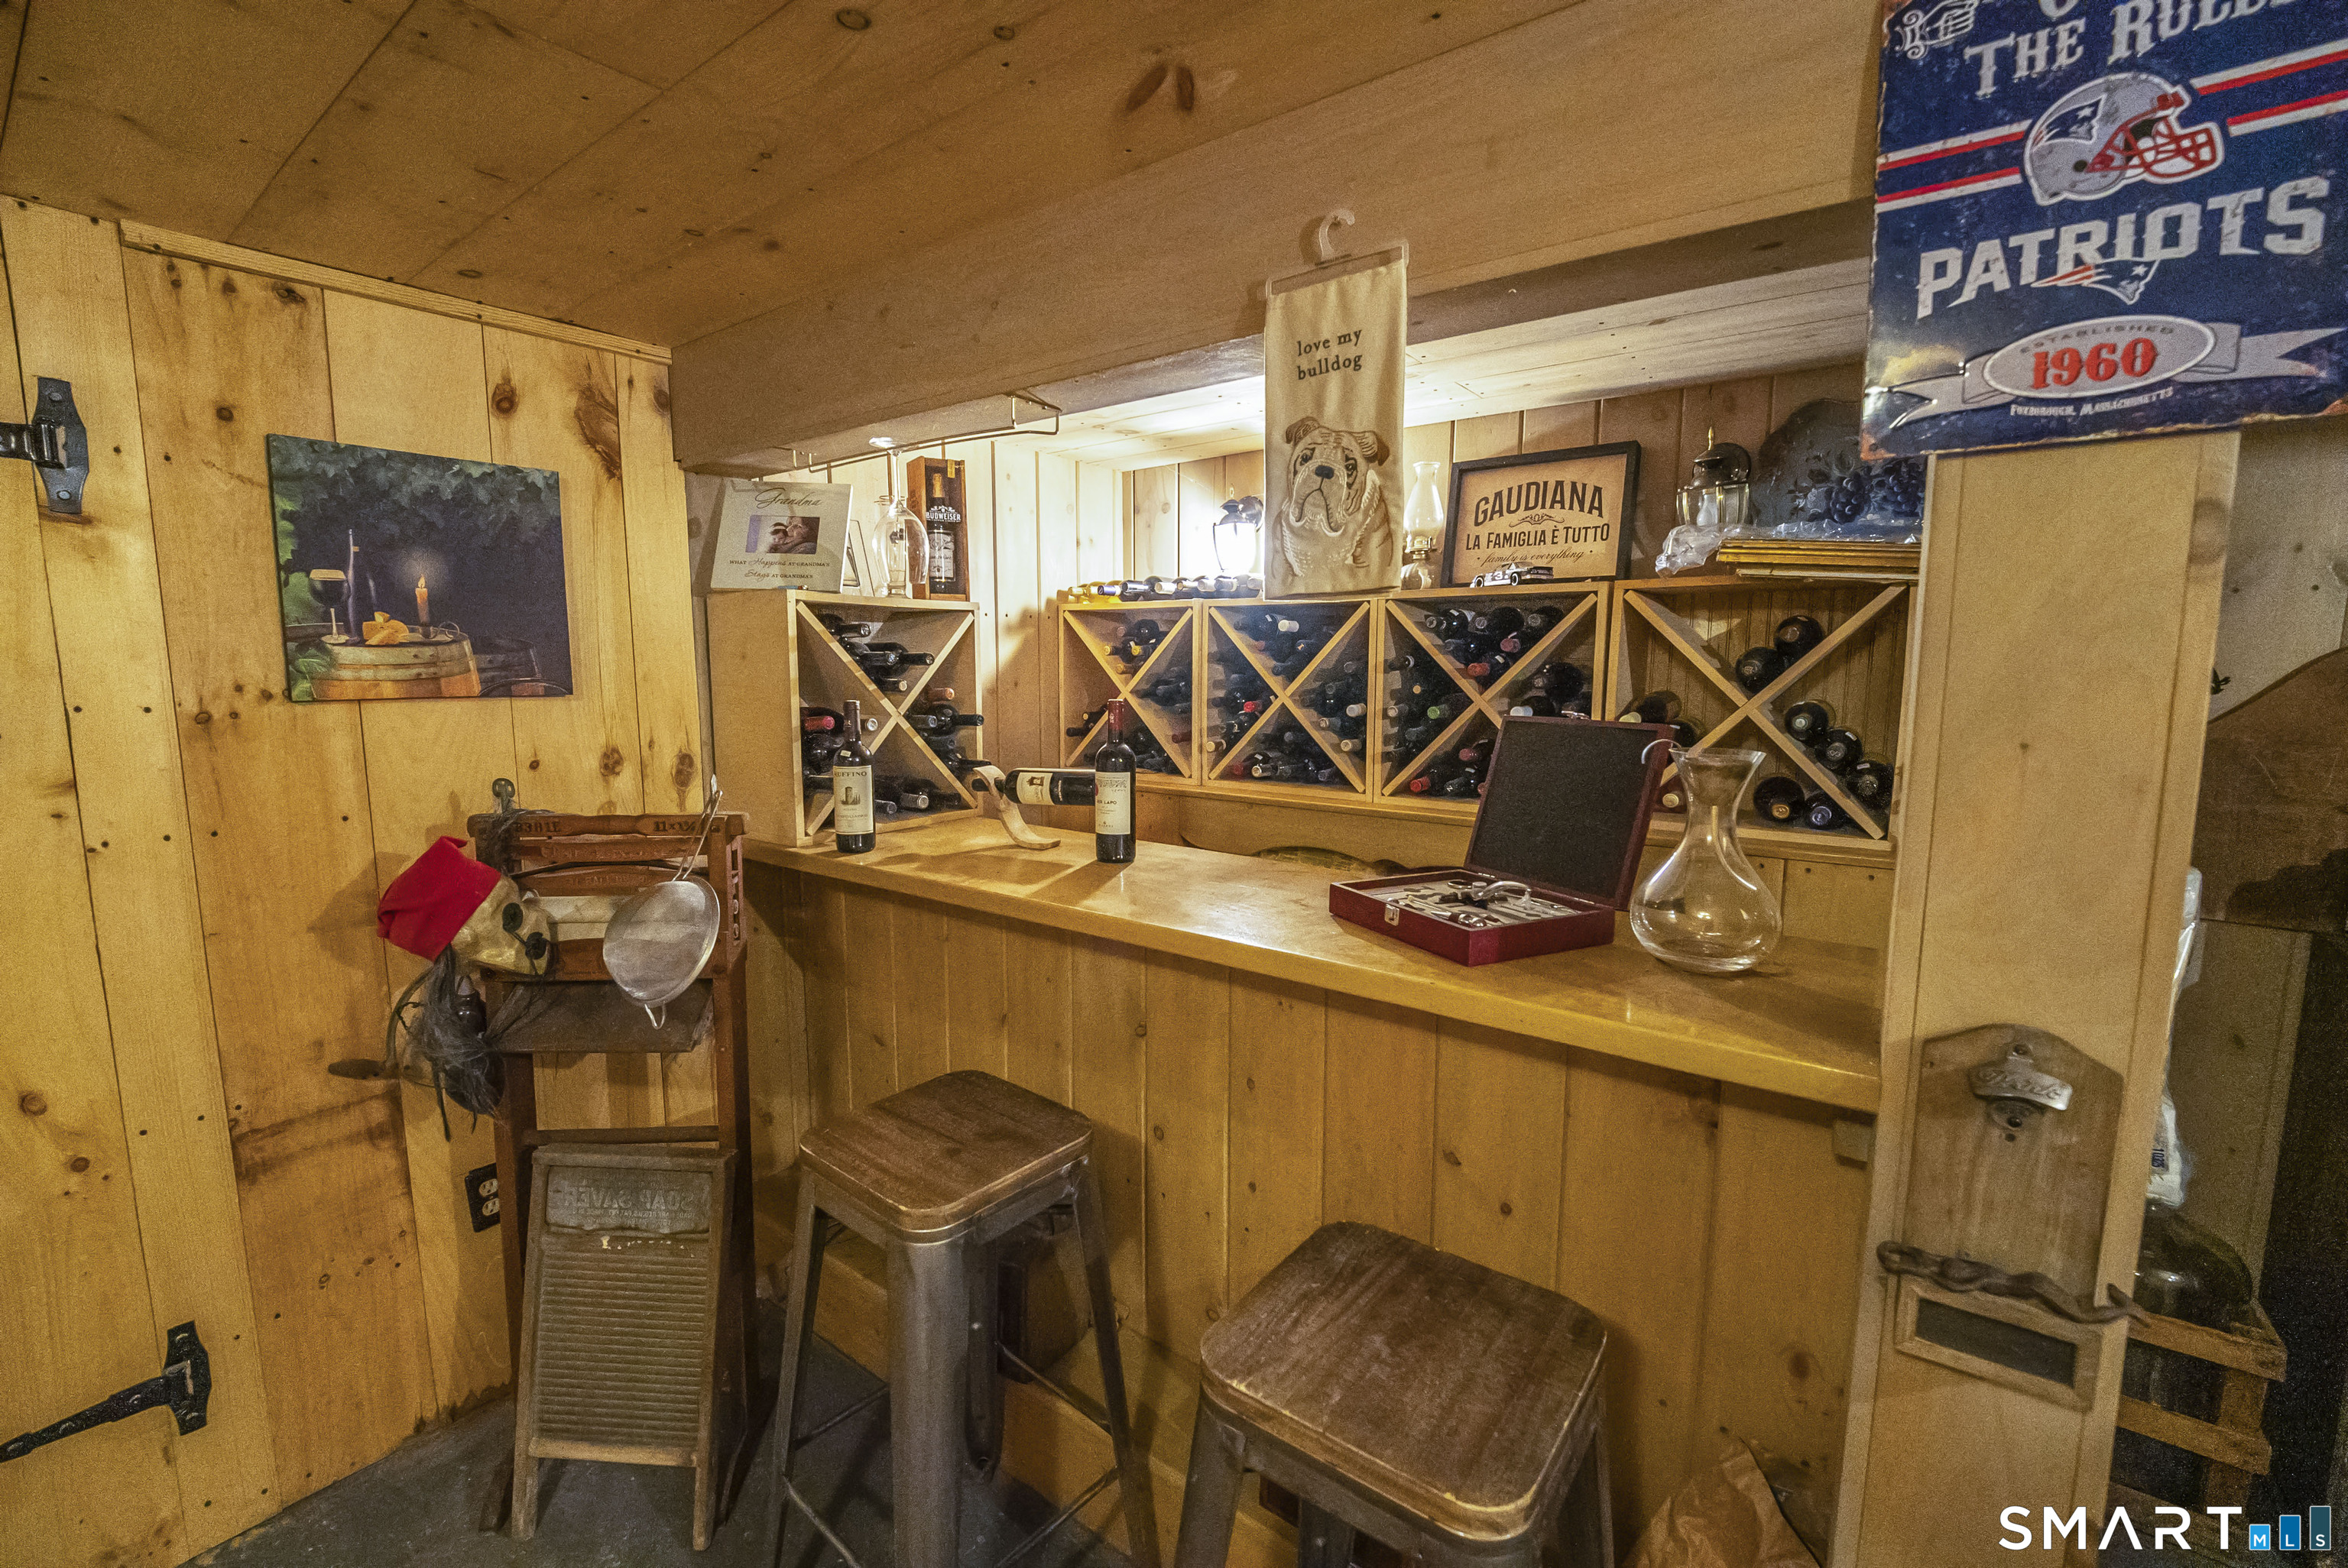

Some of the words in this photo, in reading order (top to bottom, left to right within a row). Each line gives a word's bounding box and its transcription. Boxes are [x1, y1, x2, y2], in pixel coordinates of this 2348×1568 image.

[1964, 18, 2086, 99] THE
[1915, 176, 2330, 319] PATRIOTS
[1297, 339, 1330, 357] love
[1338, 329, 1362, 347] my
[1297, 354, 1363, 381] bulldog
[2031, 337, 2157, 390] 1960
[755, 487, 822, 509] Grandma
[1474, 480, 1604, 527] GAUDIANA
[926, 511, 962, 521] BUDWEISER
[1466, 533, 1480, 550] LA
[1487, 529, 1546, 549] FAMIGLIA
[1551, 525, 1559, 545] È
[1563, 523, 1610, 544] TUTTO
[748, 557, 786, 569] Happens
[1480, 549, 1518, 568] family
[1519, 552, 1528, 562] is
[1531, 546, 1584, 565] everything
[744, 569, 770, 582] Stays
[1494, 571, 1503, 580] 3
